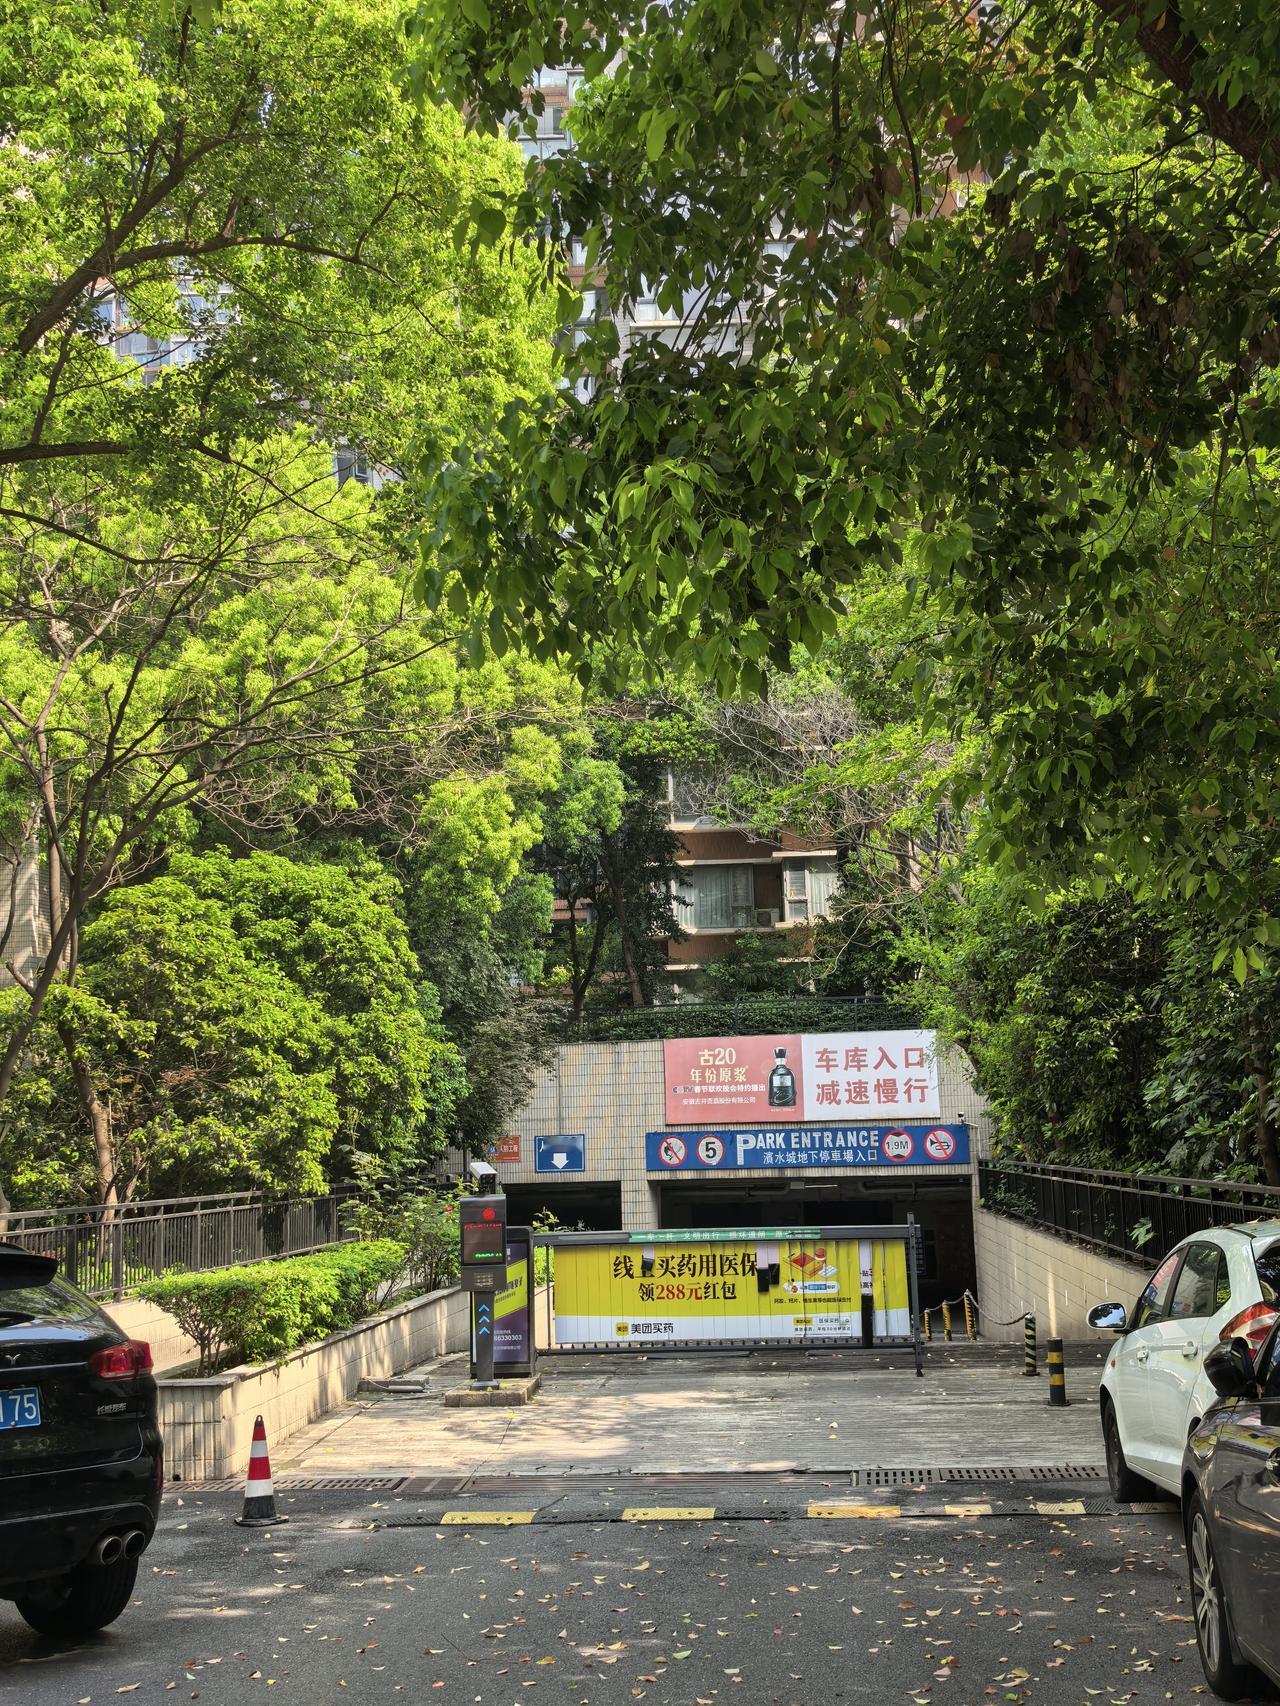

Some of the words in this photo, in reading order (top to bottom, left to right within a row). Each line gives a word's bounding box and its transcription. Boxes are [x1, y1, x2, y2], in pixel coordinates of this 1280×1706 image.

[698, 1047, 737, 1066] 古20
[815, 1046, 926, 1073] 车库入口
[690, 1067, 747, 1083] 年份原浆
[815, 1077, 929, 1106] 减速慢行
[791, 1130, 880, 1149] ENTRANCE
[885, 1140, 909, 1150] 1.9M
[705, 1141, 717, 1159] 5
[763, 1149, 878, 1165] 濱水城地下停車場入口
[638, 1280, 738, 1302] 领288元红包
[630, 1322, 675, 1335] 美团买药
